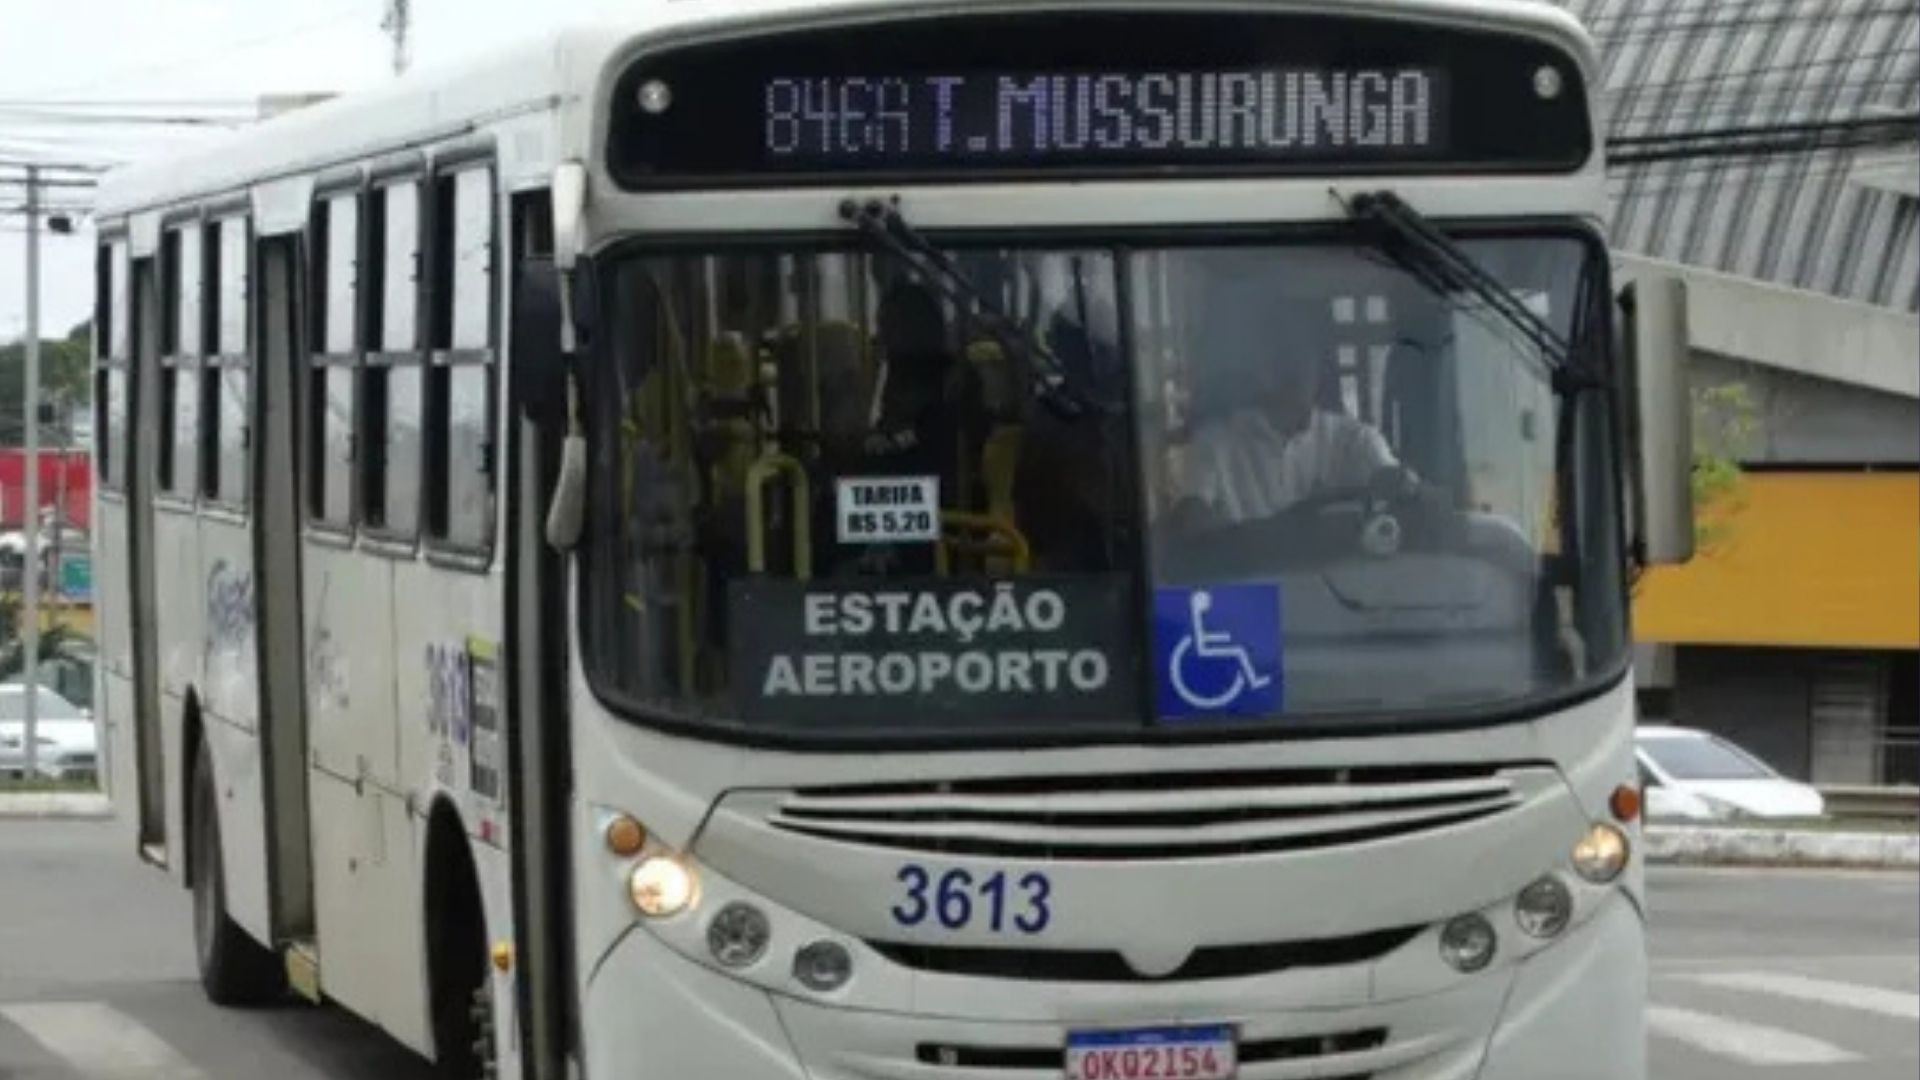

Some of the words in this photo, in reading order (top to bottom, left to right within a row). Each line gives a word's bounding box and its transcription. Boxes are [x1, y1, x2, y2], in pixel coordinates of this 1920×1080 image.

[926, 72, 1430, 150] T.MUSSURUNGA
[850, 484, 924, 506] TARIFA
[804, 582, 1065, 642] ESTAÇÃO
[763, 651, 1109, 696] AEROPORTO
[892, 864, 1052, 934] 3613
